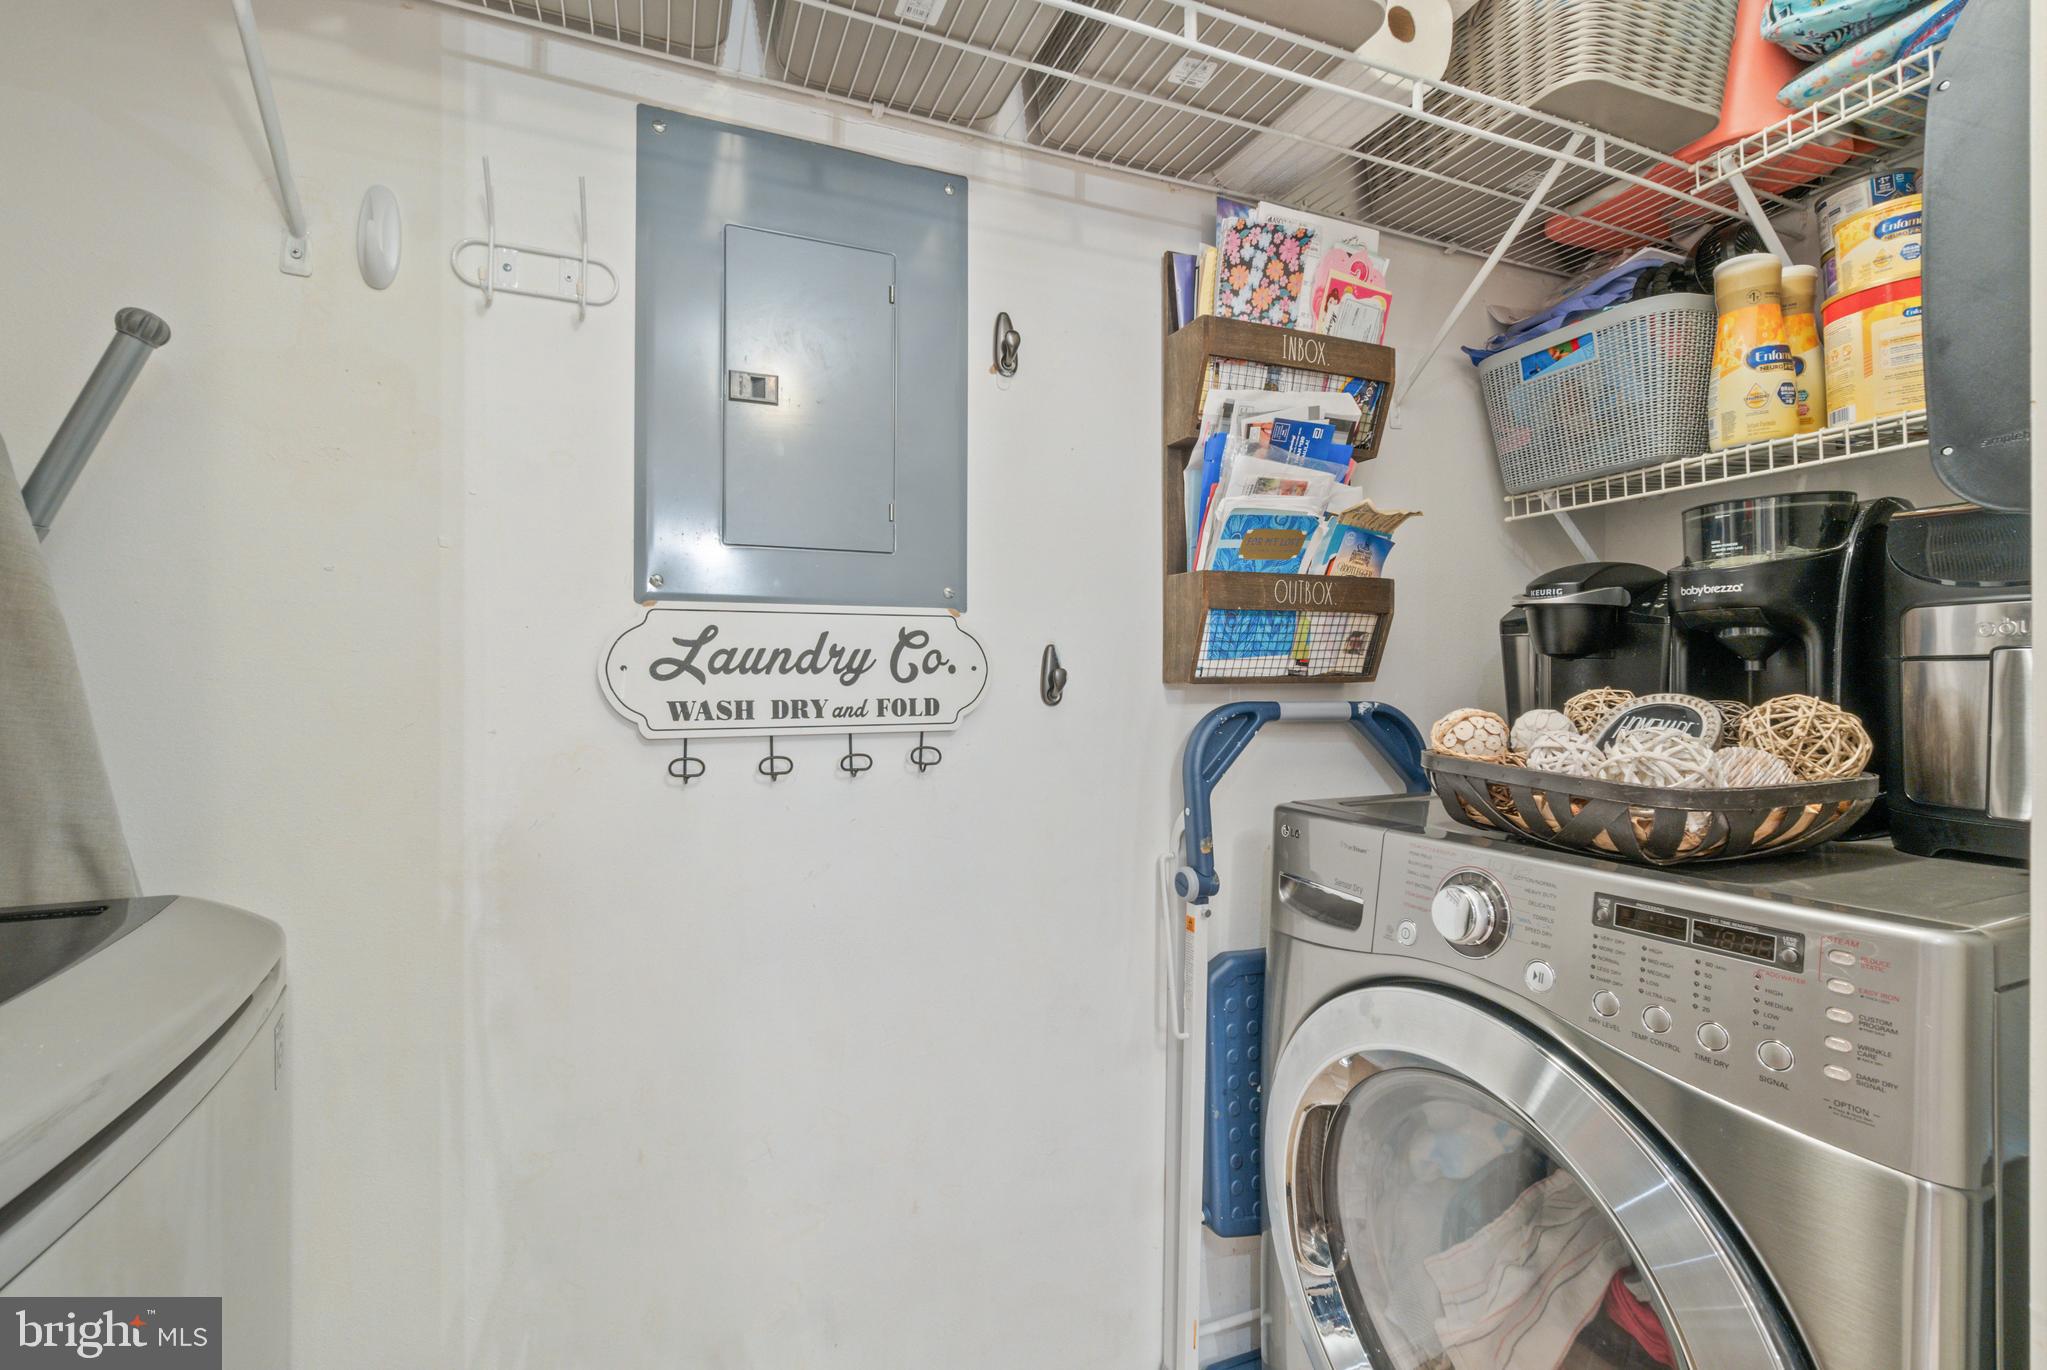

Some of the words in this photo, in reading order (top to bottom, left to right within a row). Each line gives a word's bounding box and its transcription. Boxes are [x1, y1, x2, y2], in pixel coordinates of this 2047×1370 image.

[1530, 588, 1563, 597] KEURIG
[1680, 583, 1744, 597] babybrezza
[649, 624, 877, 686] Laundry
[890, 626, 956, 684] Co.
[666, 700, 755, 722] WASH
[771, 699, 828, 720] DRY
[832, 698, 870, 719] and
[876, 698, 940, 718] FOLD
[1597, 965, 1610, 974] LESS
[1647, 969, 1671, 979] MEDIUM
[1704, 972, 1712, 980] 50
[1646, 979, 1659, 988] LOW
[1703, 983, 1712, 991] 40
[1645, 989, 1662, 999] ULTRA
[1765, 988, 1784, 998] HIGH
[1764, 1000, 1793, 1012] MEDIUM
[1763, 1012, 1780, 1021] LOW
[1859, 1014, 1893, 1027] CUSTOM
[1589, 1016, 1601, 1025] DRY
[1602, 1020, 1620, 1032] LEVEL
[1763, 1023, 1776, 1031] OFF
[1858, 1020, 1898, 1035] PROGRAM
[1631, 1031, 1649, 1041] TEMP
[1650, 1037, 1681, 1053] CONTROL
[1857, 1050, 1878, 1060] CARE
[1858, 1043, 1892, 1058] WRINKLE
[1694, 1052, 1713, 1064] TIME
[1713, 1058, 1730, 1070] DRY
[1759, 1074, 1790, 1091] SIGNAL
[1856, 1073, 1880, 1084] DAMP
[1881, 1080, 1898, 1090] DRY
[1856, 1079, 1886, 1093] SIGNAL
[1833, 1099, 1870, 1117] OPTION
